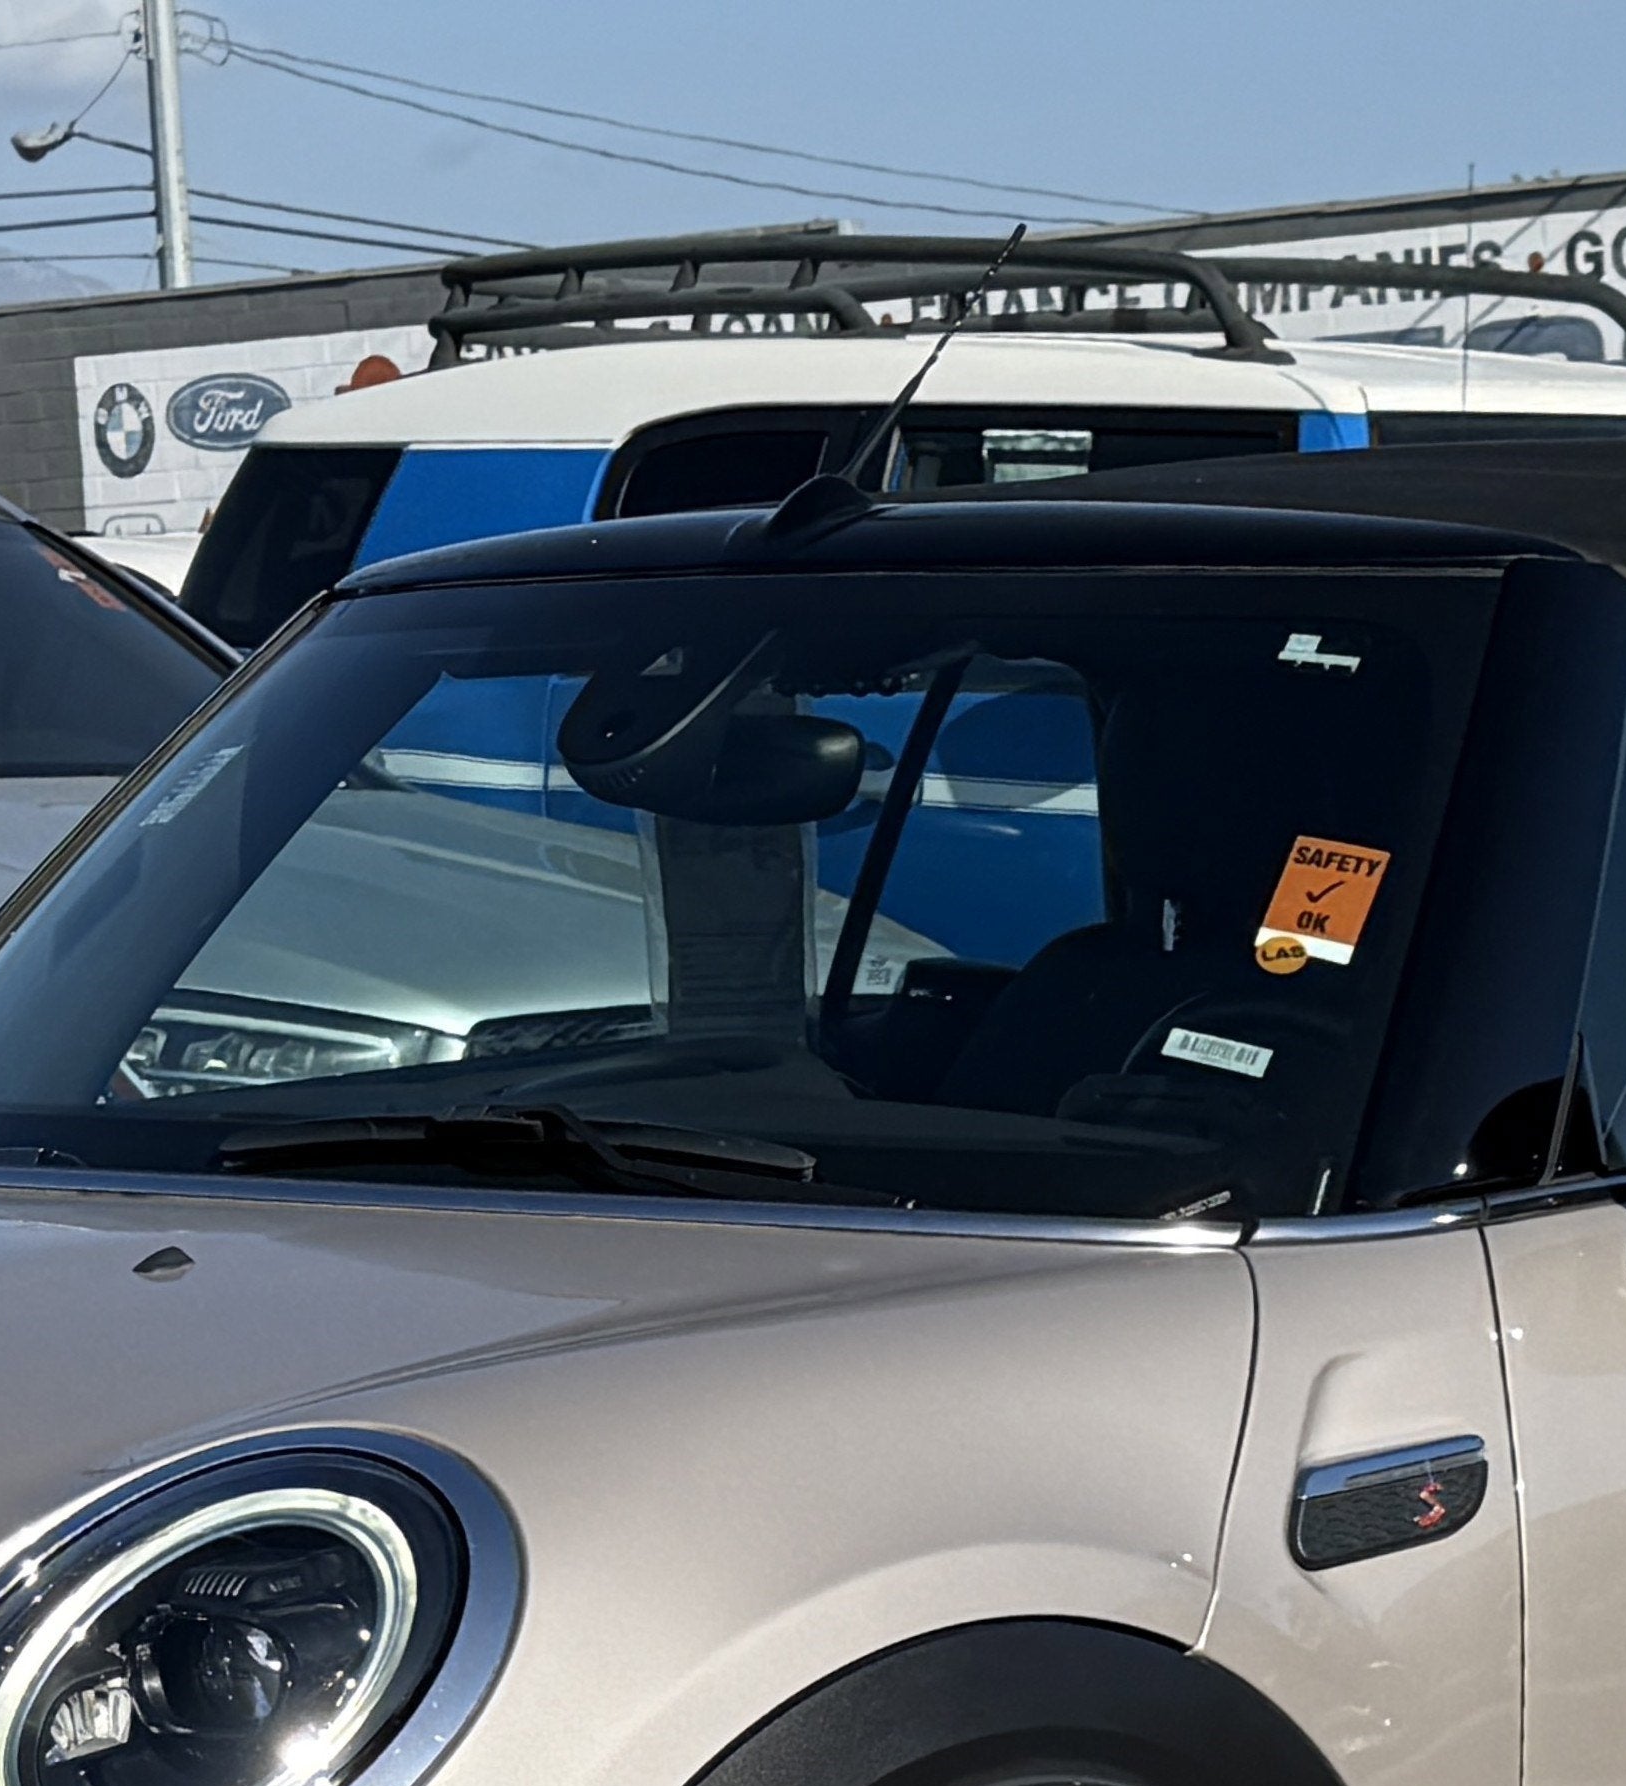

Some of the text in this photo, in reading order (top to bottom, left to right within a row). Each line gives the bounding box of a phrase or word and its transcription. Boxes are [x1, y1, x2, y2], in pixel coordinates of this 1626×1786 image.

[193, 389, 264, 433] Ford
[1292, 844, 1381, 878] SAFETY
[1296, 910, 1331, 934] OK
